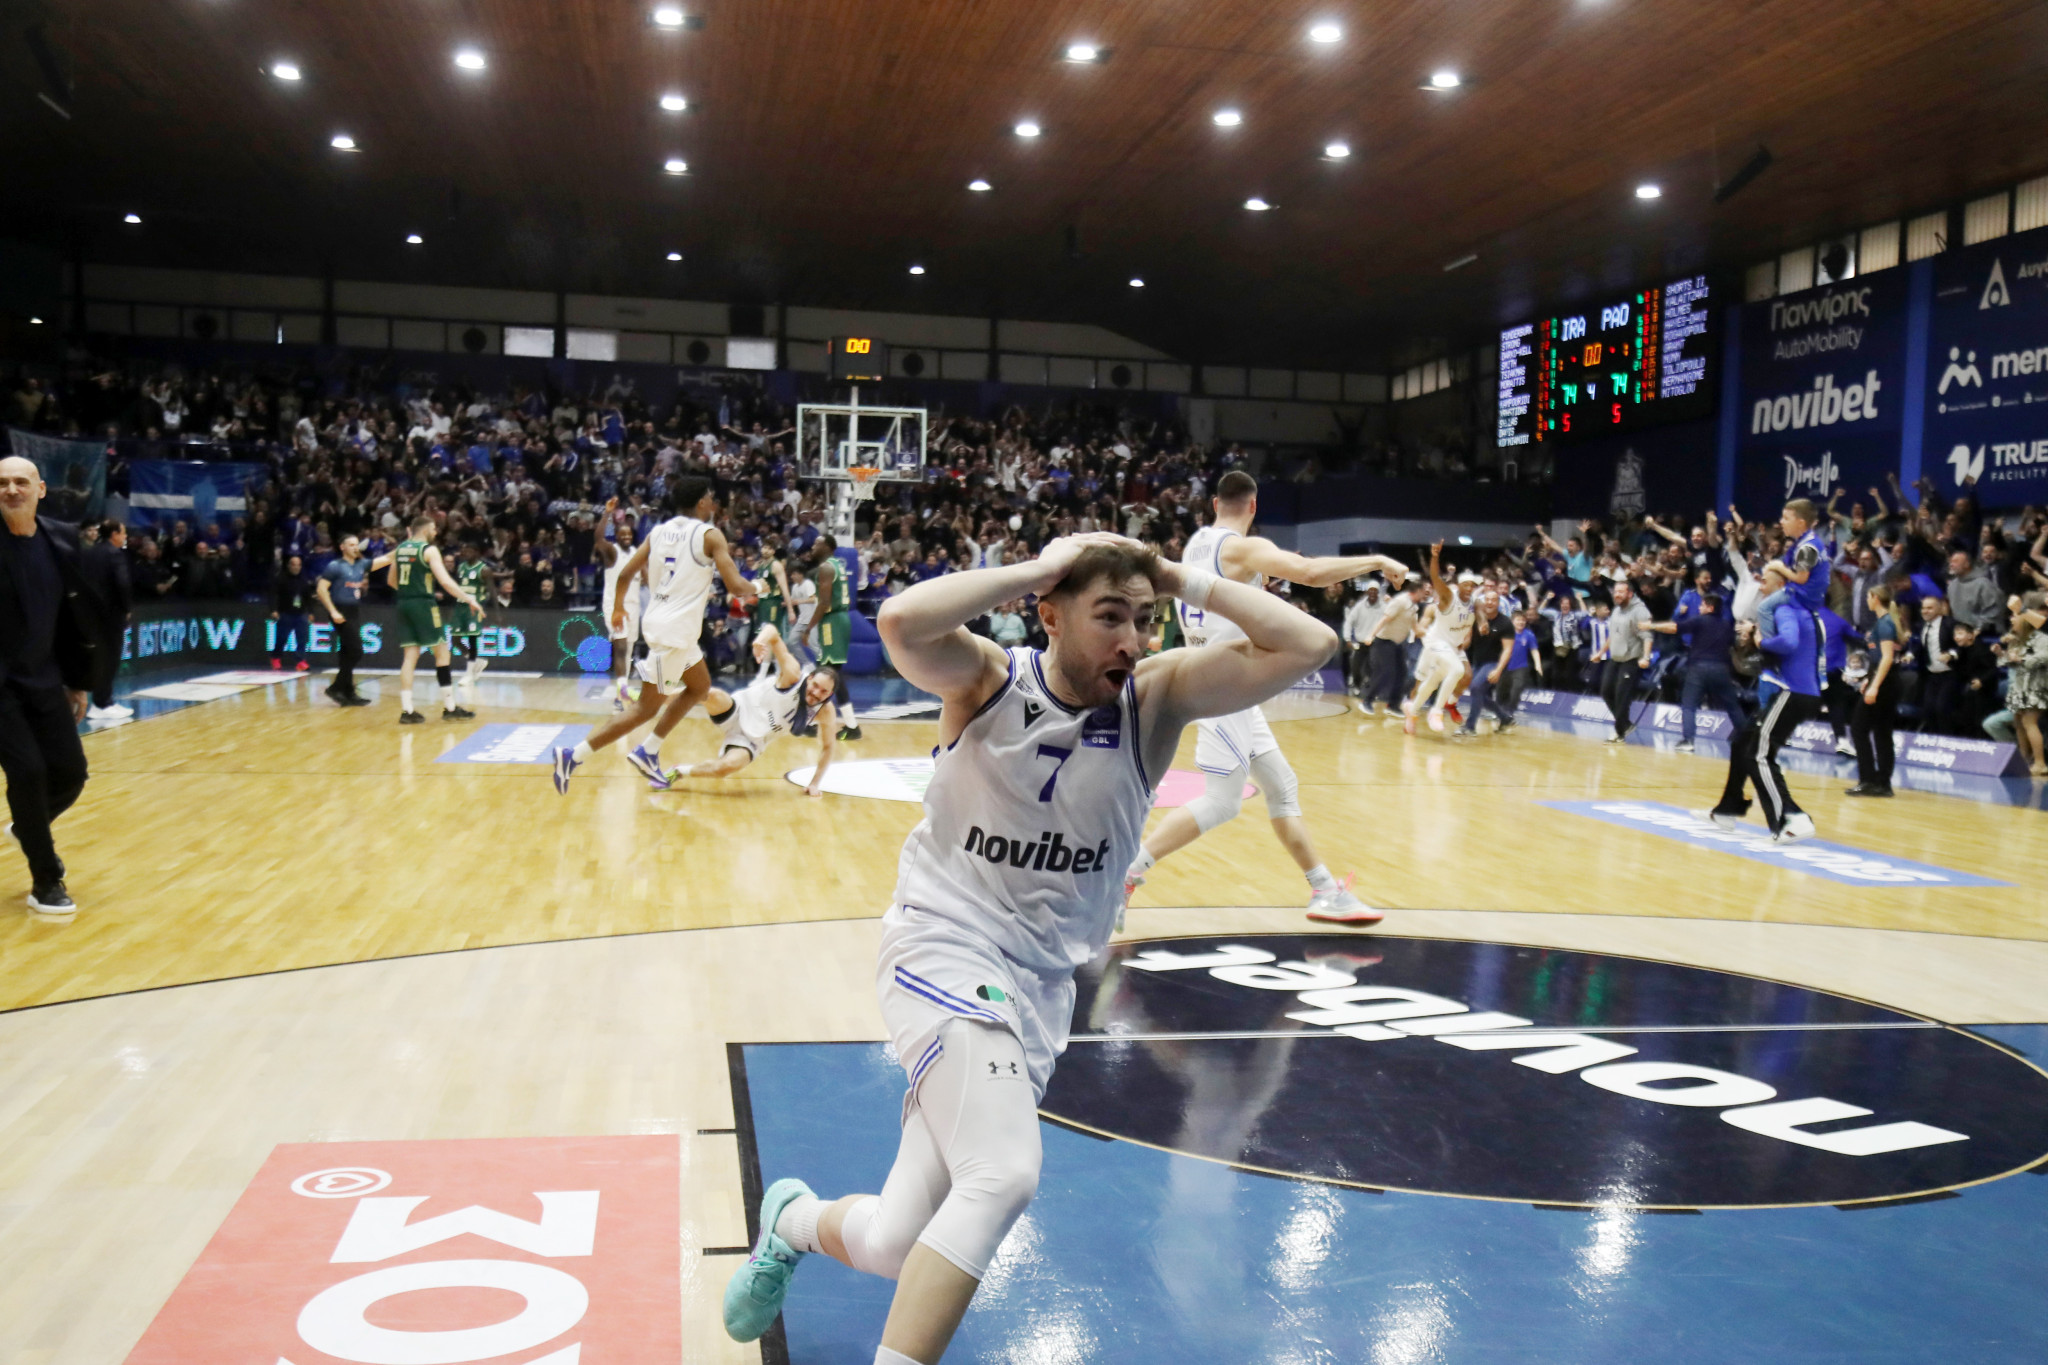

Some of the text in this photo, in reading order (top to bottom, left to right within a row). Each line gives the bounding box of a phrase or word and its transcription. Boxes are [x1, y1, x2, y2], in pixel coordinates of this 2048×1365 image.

[1666, 279, 1693, 297] SHORTS
[1561, 315, 1587, 341] IRA
[1601, 302, 1630, 331] PAO
[1774, 327, 1863, 361] AutoMobility
[1561, 384, 1577, 405] 74
[1586, 382, 1596, 400] 4
[1610, 372, 1629, 396] 74
[1611, 402, 1622, 424] 5
[1752, 369, 1882, 435] novibet
[1562, 412, 1571, 432] 5
[1991, 440, 2048, 467] TRUE
[1990, 468, 2048, 481] FACILITY
[1091, 736, 1110, 744] GBL
[1036, 744, 1074, 802] 7
[964, 825, 1110, 875] novibet
[1122, 944, 1971, 1157] novibet
